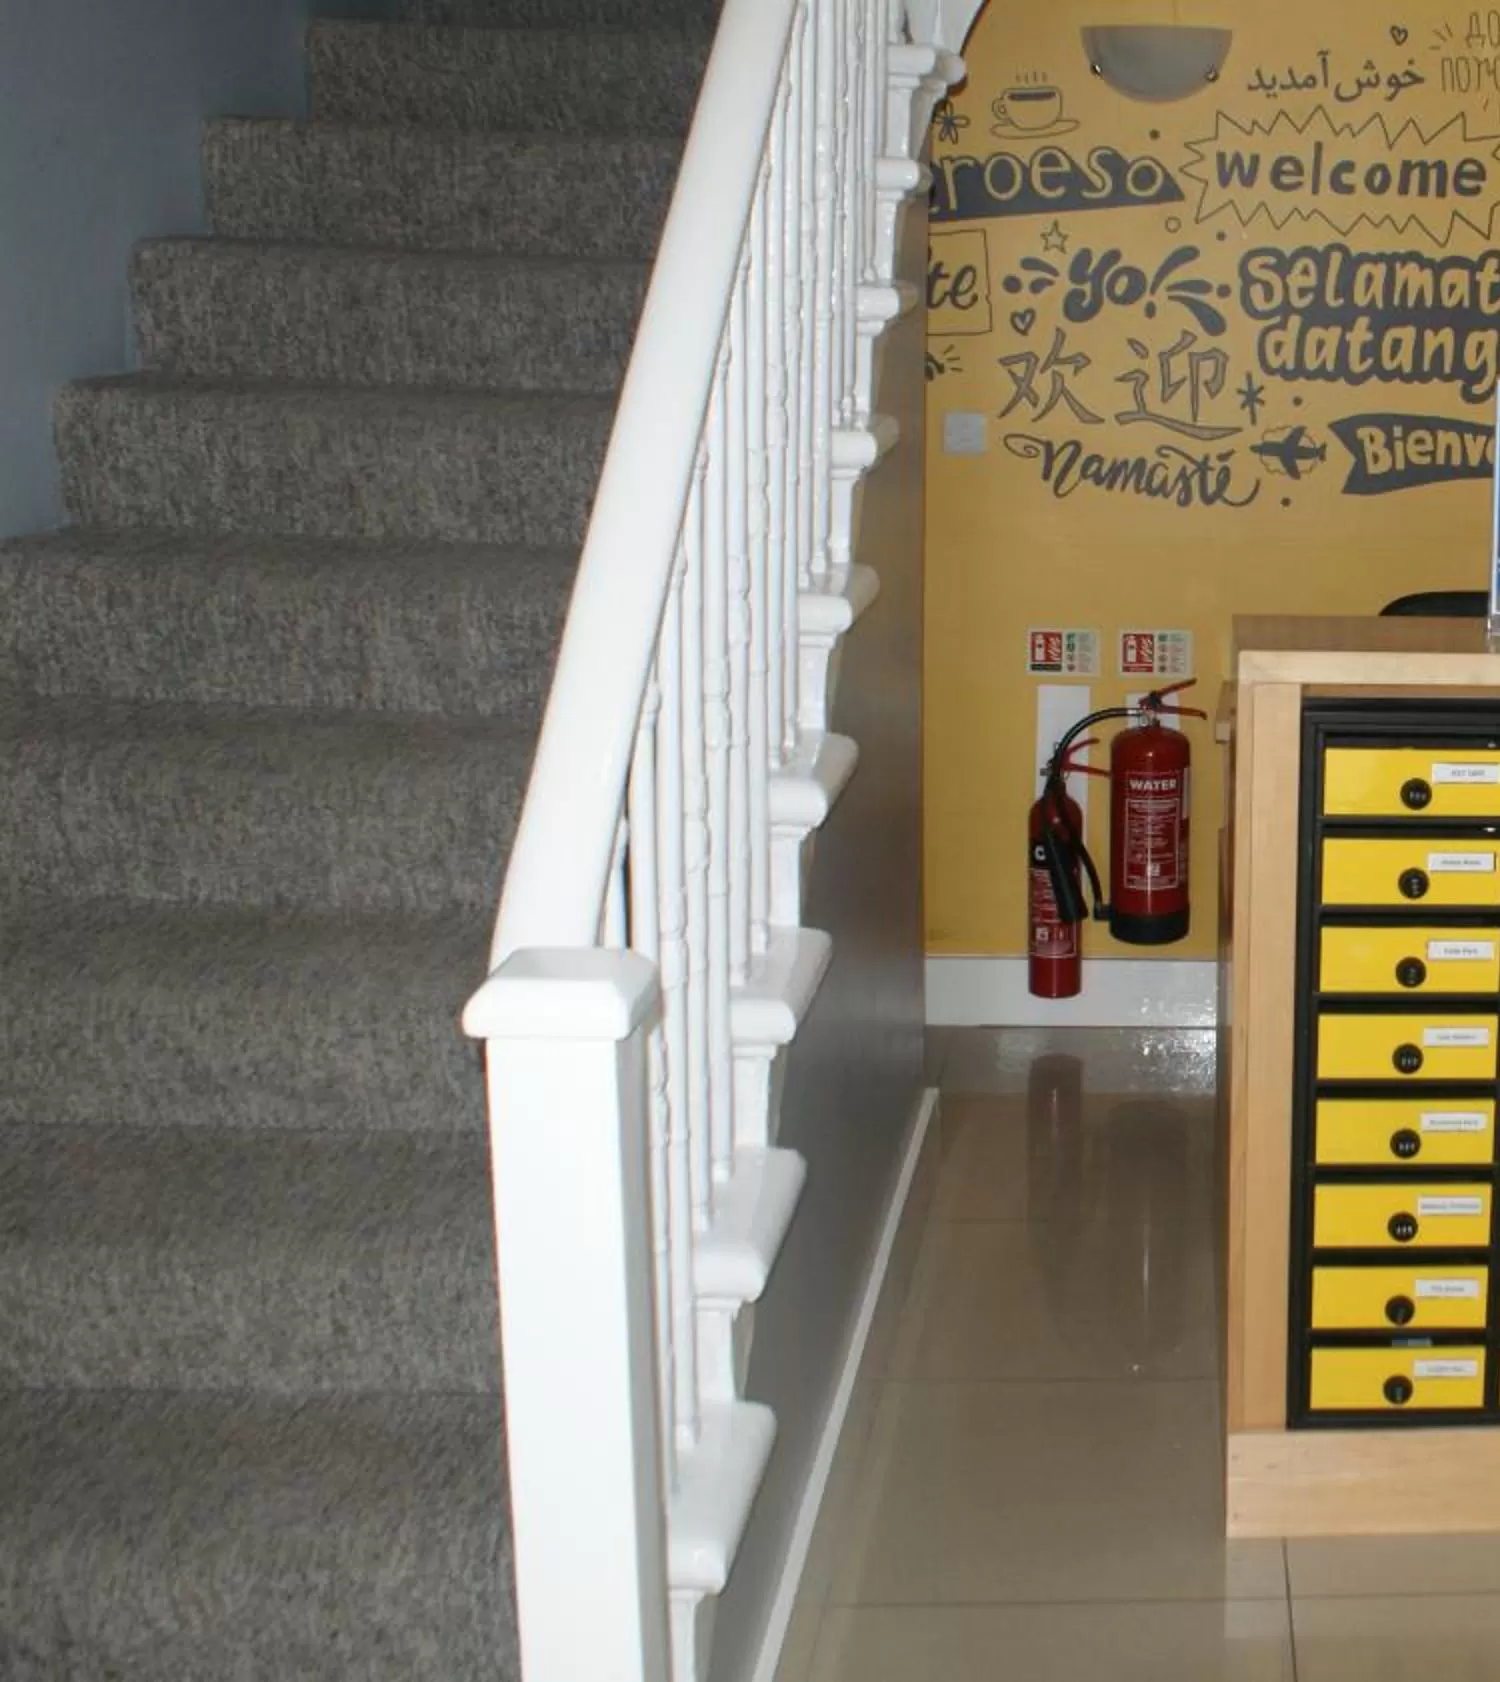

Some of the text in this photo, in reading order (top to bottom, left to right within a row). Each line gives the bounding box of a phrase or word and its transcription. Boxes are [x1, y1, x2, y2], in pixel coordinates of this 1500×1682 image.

[1247, 49, 1425, 103] خوش آمدید
[929, 144, 1166, 214] roeso
[1214, 140, 1489, 199] welcome
[925, 246, 980, 311] te
[998, 326, 1243, 441] 欢迎
[1262, 314, 1500, 396] datang
[1128, 779, 1178, 791] WATER
